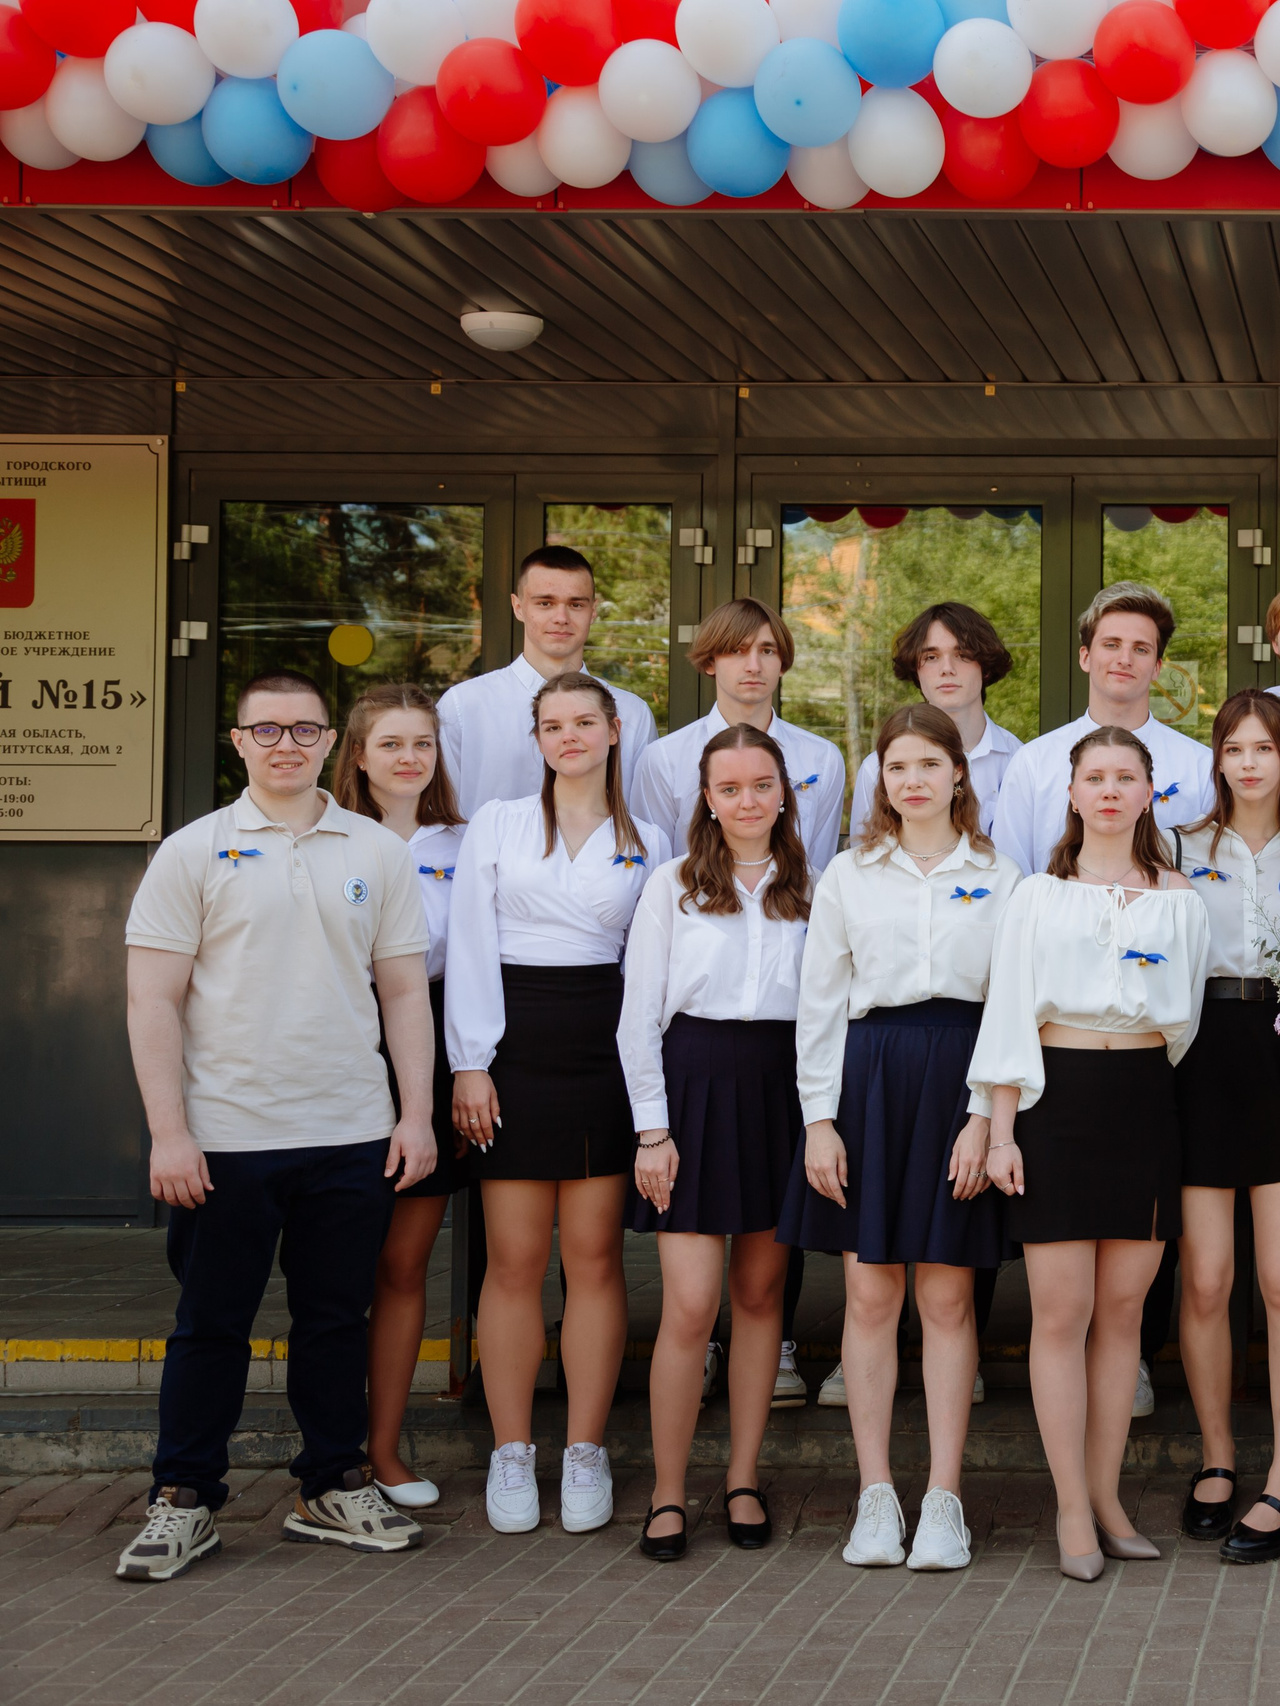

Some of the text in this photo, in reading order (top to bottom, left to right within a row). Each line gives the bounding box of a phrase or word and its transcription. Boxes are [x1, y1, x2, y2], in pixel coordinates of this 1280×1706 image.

[6, 461, 91, 471] ГОРОДСКОГО
[4, 631, 90, 641] БЮДЖЕТНОЕ
[24, 647, 115, 657] УЧРЕЖДЕНИЕ
[32, 679, 147, 710] №15»
[23, 729, 86, 739] ОБЛАСТЬ,
[0, 745, 123, 755] ИТУТСКАЯ, ДОМ 2
